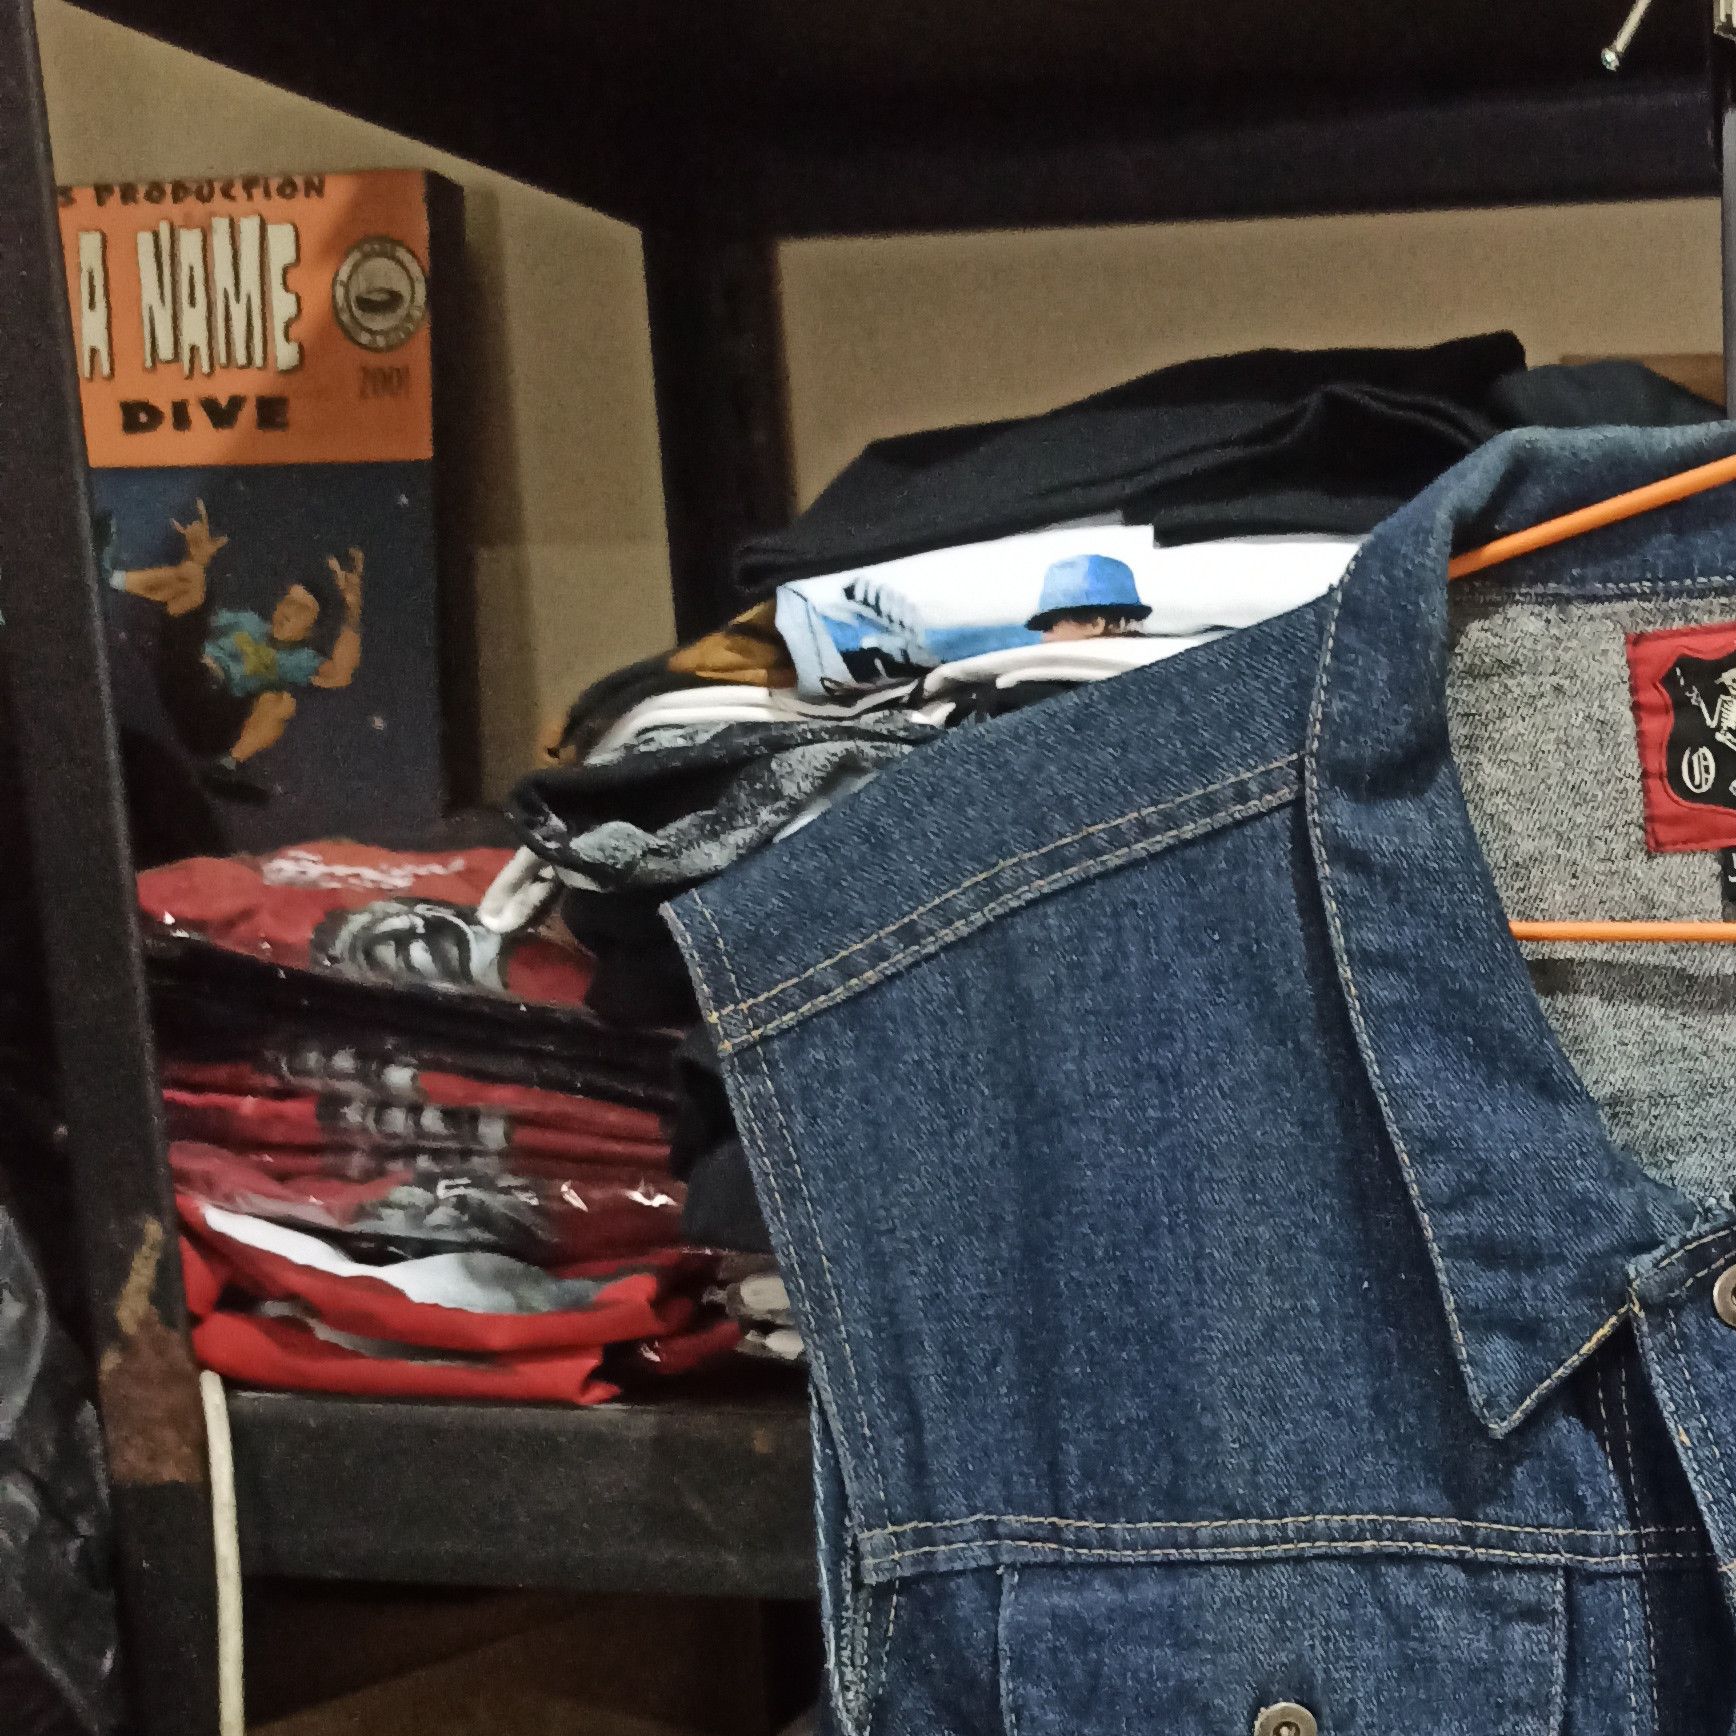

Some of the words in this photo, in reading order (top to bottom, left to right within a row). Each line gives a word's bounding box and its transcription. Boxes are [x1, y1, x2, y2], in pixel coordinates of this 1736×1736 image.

[94, 174, 327, 207] PRODUCTION
[78, 230, 113, 379] A
[137, 214, 303, 379] NAME
[120, 395, 289, 434] DIVE
